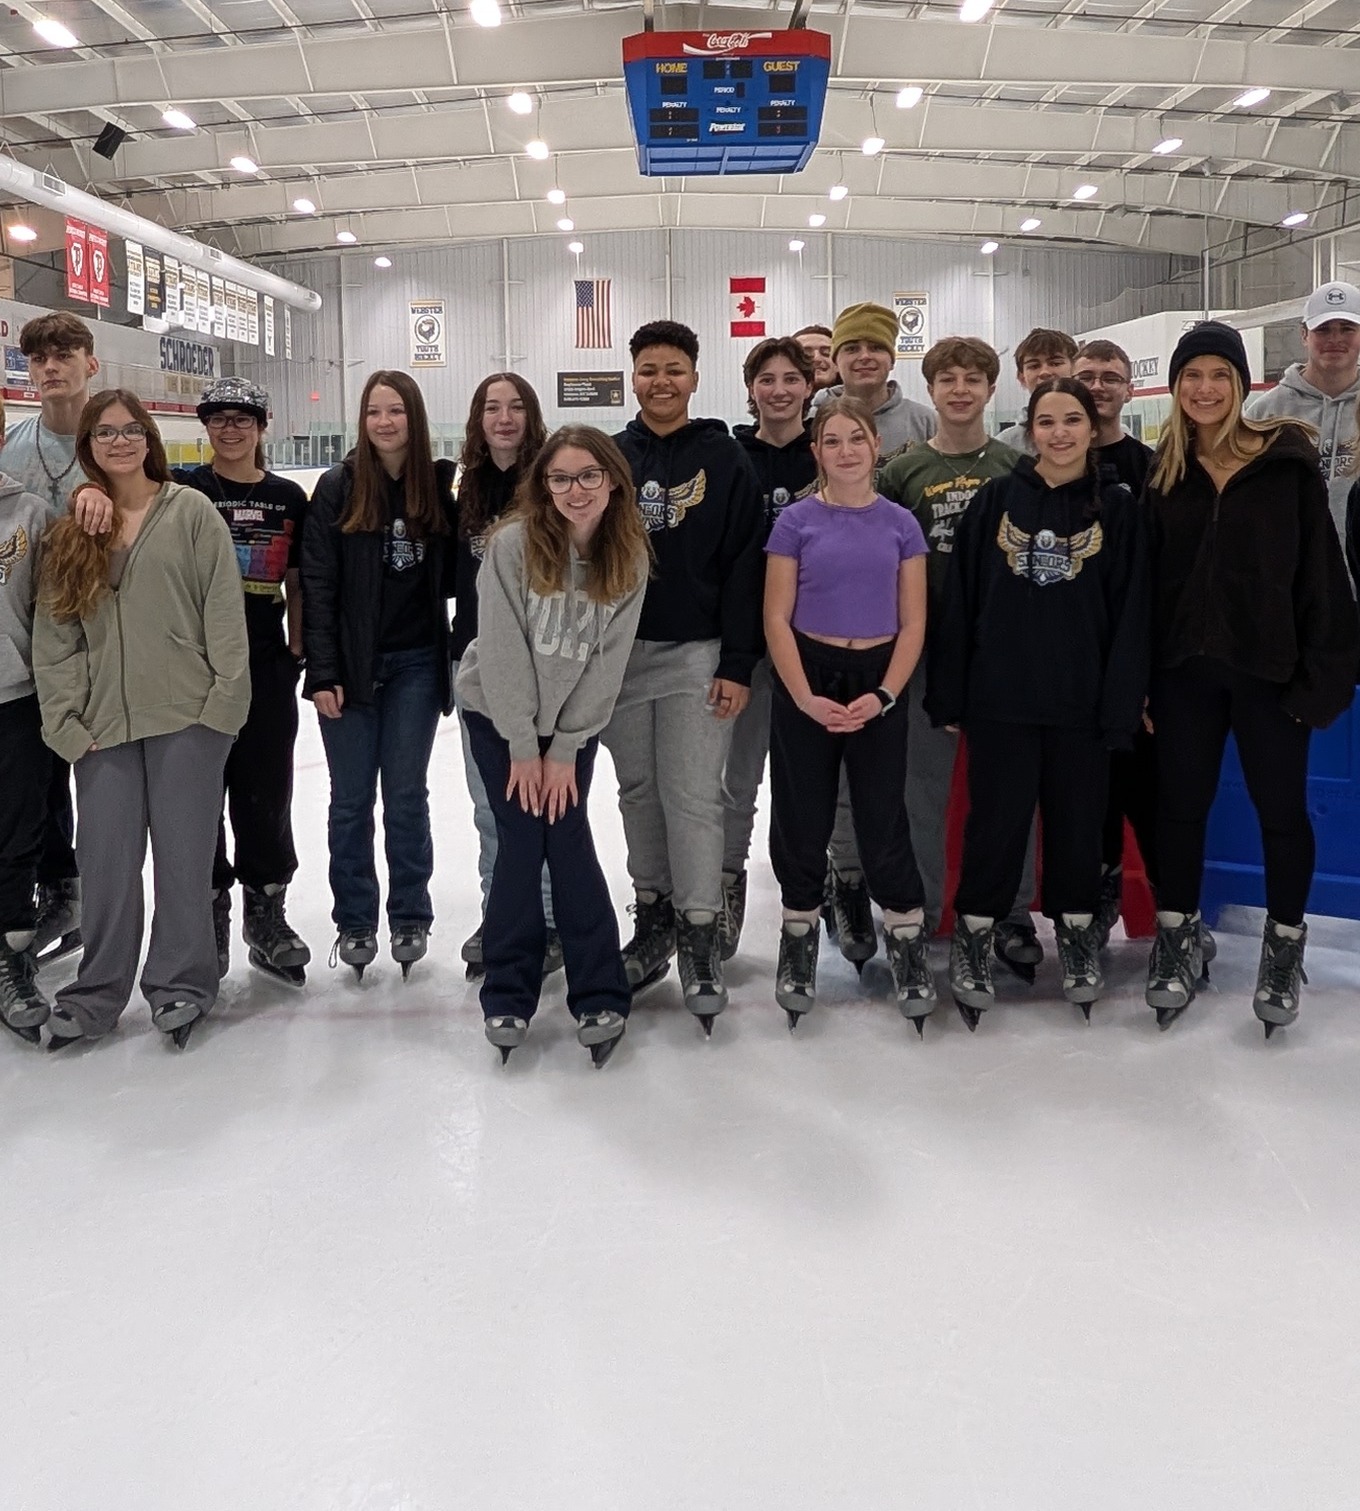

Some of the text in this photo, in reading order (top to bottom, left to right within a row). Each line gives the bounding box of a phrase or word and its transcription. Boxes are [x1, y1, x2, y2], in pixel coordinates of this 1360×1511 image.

[656, 60, 800, 74] HOME GUEST
[160, 336, 214, 379] SCHROEDER
[214, 500, 286, 512] ERIODIC TABLE OF
[232, 509, 265, 522] MARVEL
